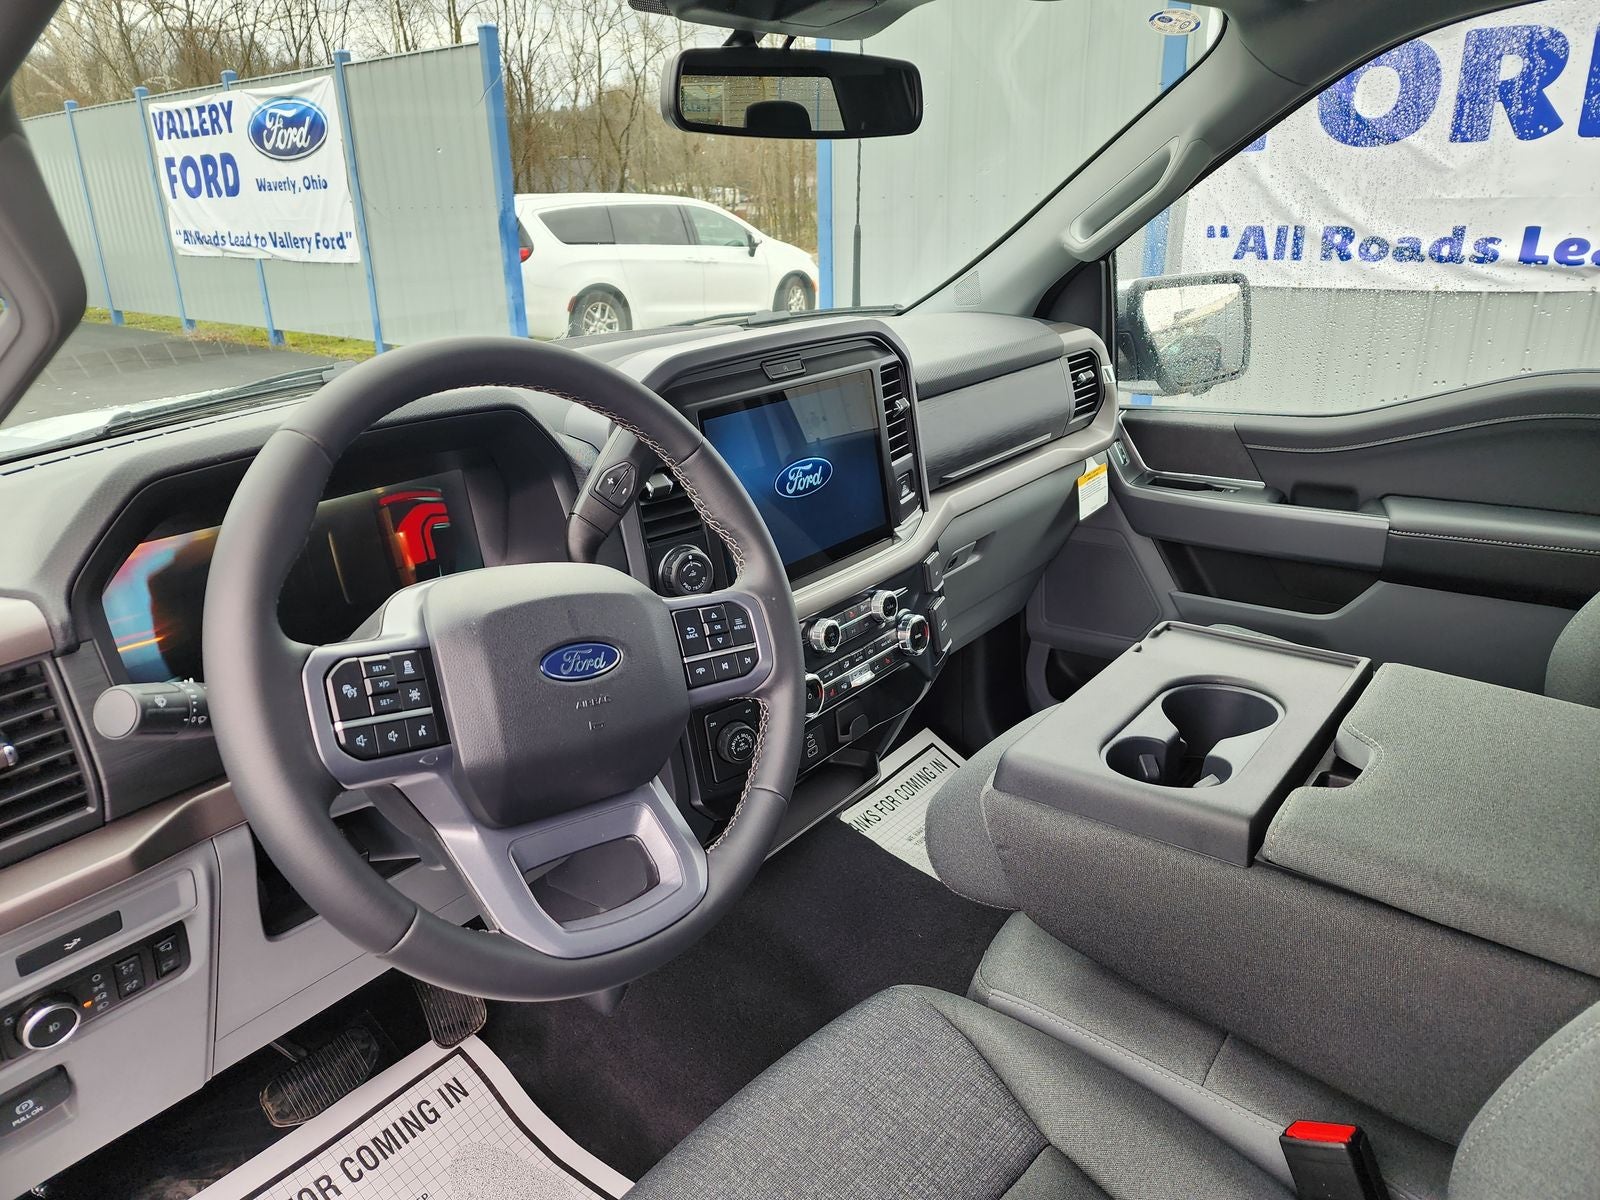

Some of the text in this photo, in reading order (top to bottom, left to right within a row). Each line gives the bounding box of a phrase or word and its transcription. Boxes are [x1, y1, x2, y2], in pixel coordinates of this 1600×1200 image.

[1242, 24, 1600, 153] OR
[151, 100, 233, 141] VALLERY
[263, 107, 311, 150] Ford
[164, 152, 241, 199] FORD
[255, 174, 328, 195] Waverly, Ohio
[195, 229, 227, 247] Roads
[228, 230, 252, 248] Lead
[254, 232, 267, 248] to
[268, 231, 313, 253] Vallery
[314, 231, 353, 250] Ford"
[1206, 225, 1306, 261] "All
[1320, 225, 1503, 265] Roads
[785, 462, 823, 495] Ford
[685, 632, 699, 640] BACK
[372, 664, 387, 672] SET+
[560, 648, 607, 675] Ford
[874, 795, 902, 816] FOR
[894, 766, 937, 801] COMING
[929, 757, 948, 774] IN
[339, 1099, 442, 1183] COMING
[436, 1076, 470, 1109] IN
